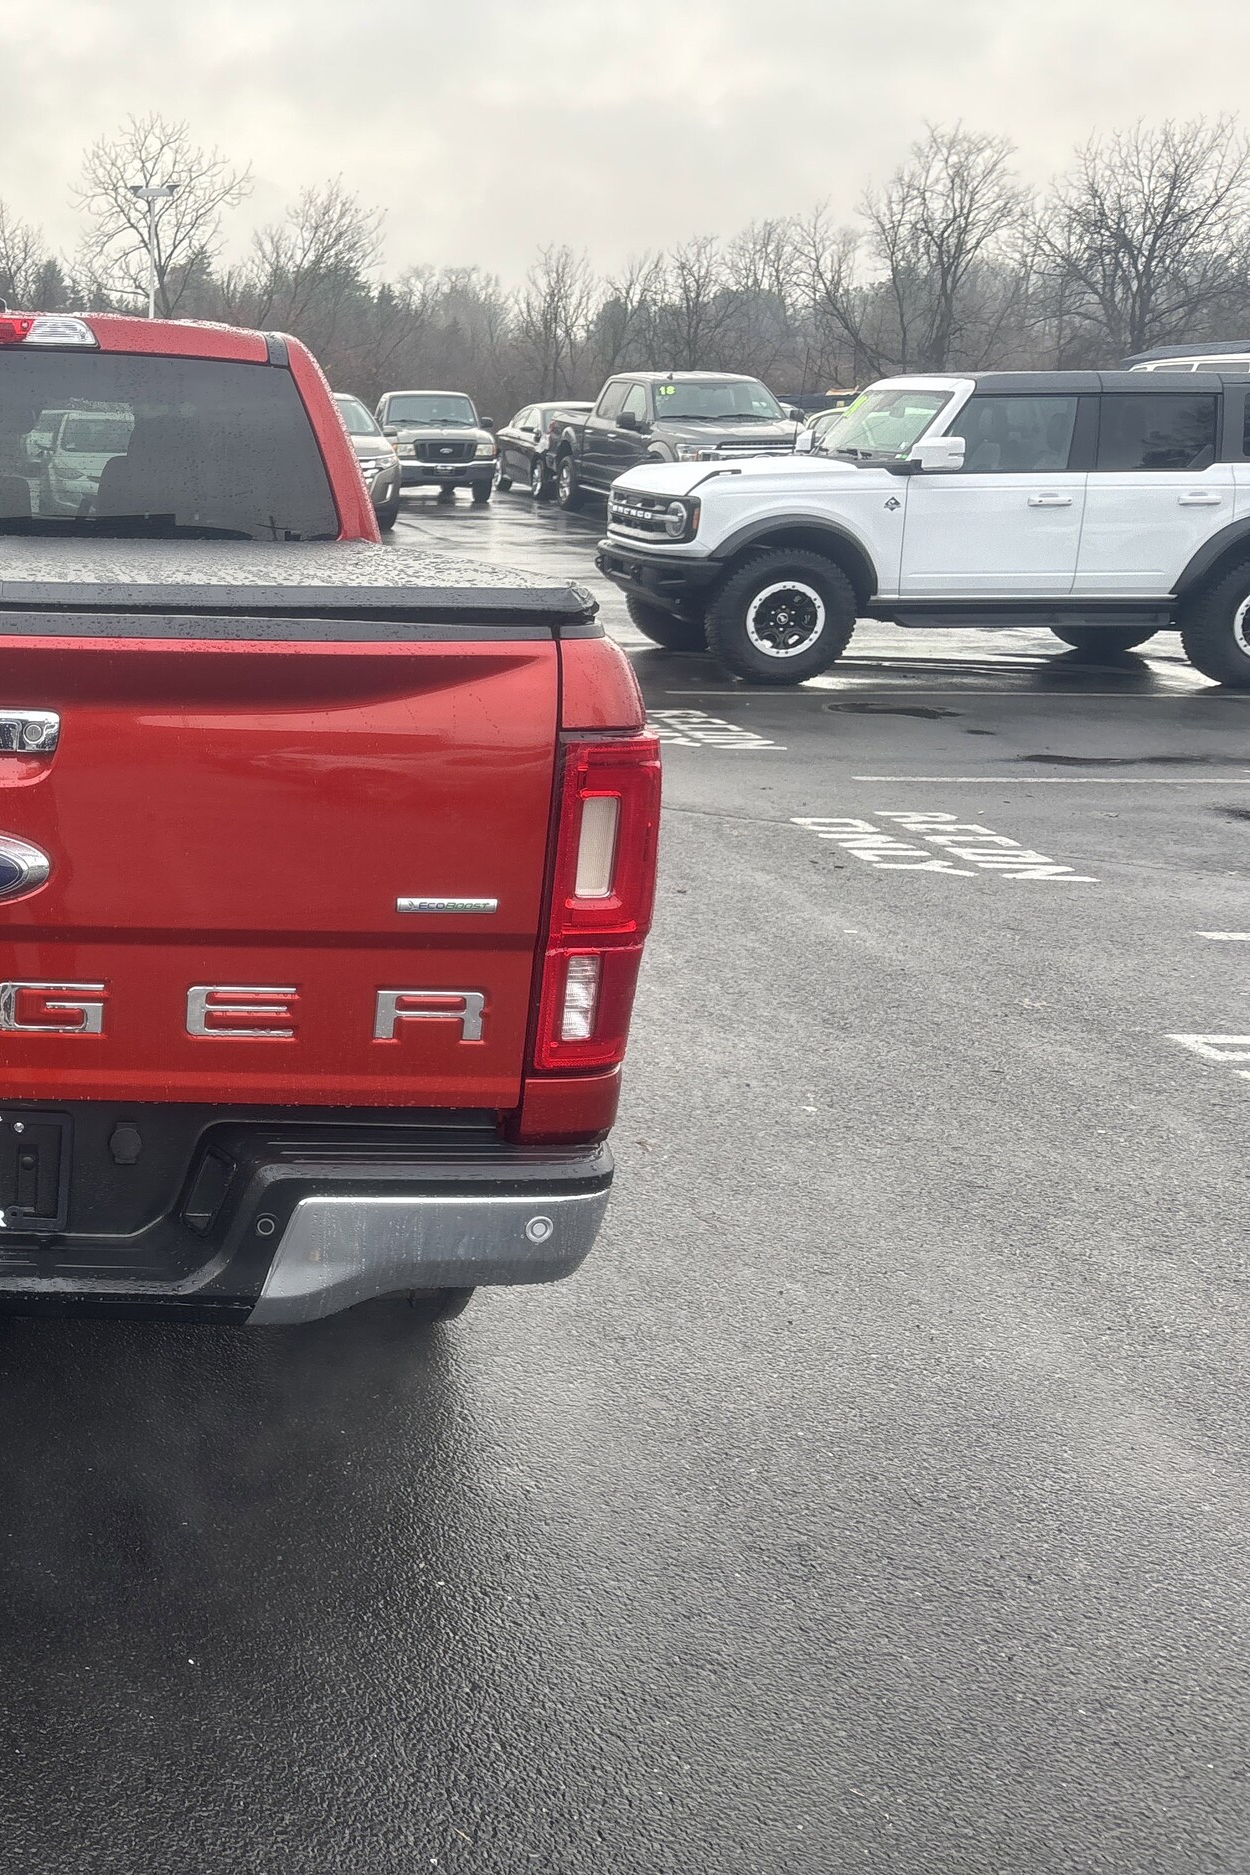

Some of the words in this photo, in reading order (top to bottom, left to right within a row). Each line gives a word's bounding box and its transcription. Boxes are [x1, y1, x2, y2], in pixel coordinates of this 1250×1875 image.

[659, 385, 675, 395] 18
[612, 504, 653, 519] BRONCO
[789, 817, 980, 877] ONLY
[873, 811, 1102, 883] RECON
